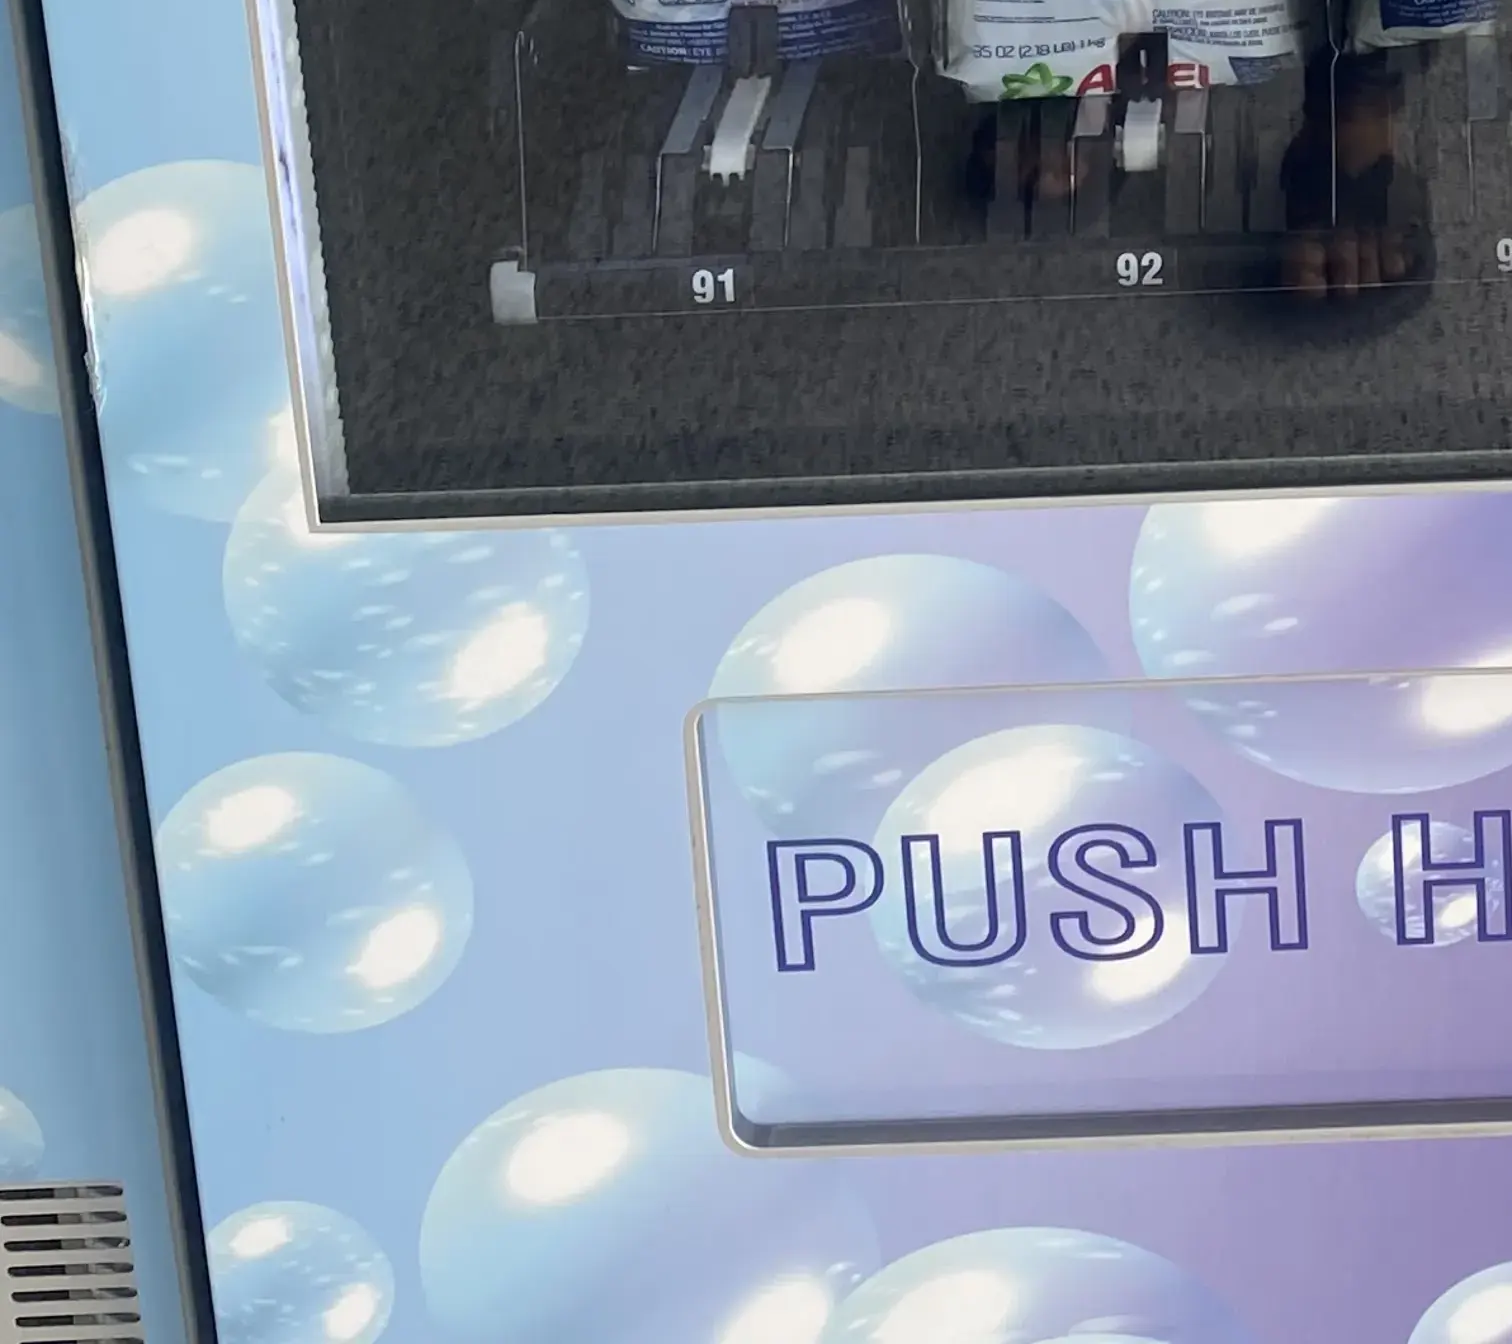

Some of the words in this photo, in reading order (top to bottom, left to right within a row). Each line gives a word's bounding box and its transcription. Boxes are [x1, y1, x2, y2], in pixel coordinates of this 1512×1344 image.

[995, 45, 1015, 58] OZ
[691, 267, 737, 304] 91
[1116, 251, 1164, 287] 92
[765, 816, 1313, 973] PUSH
